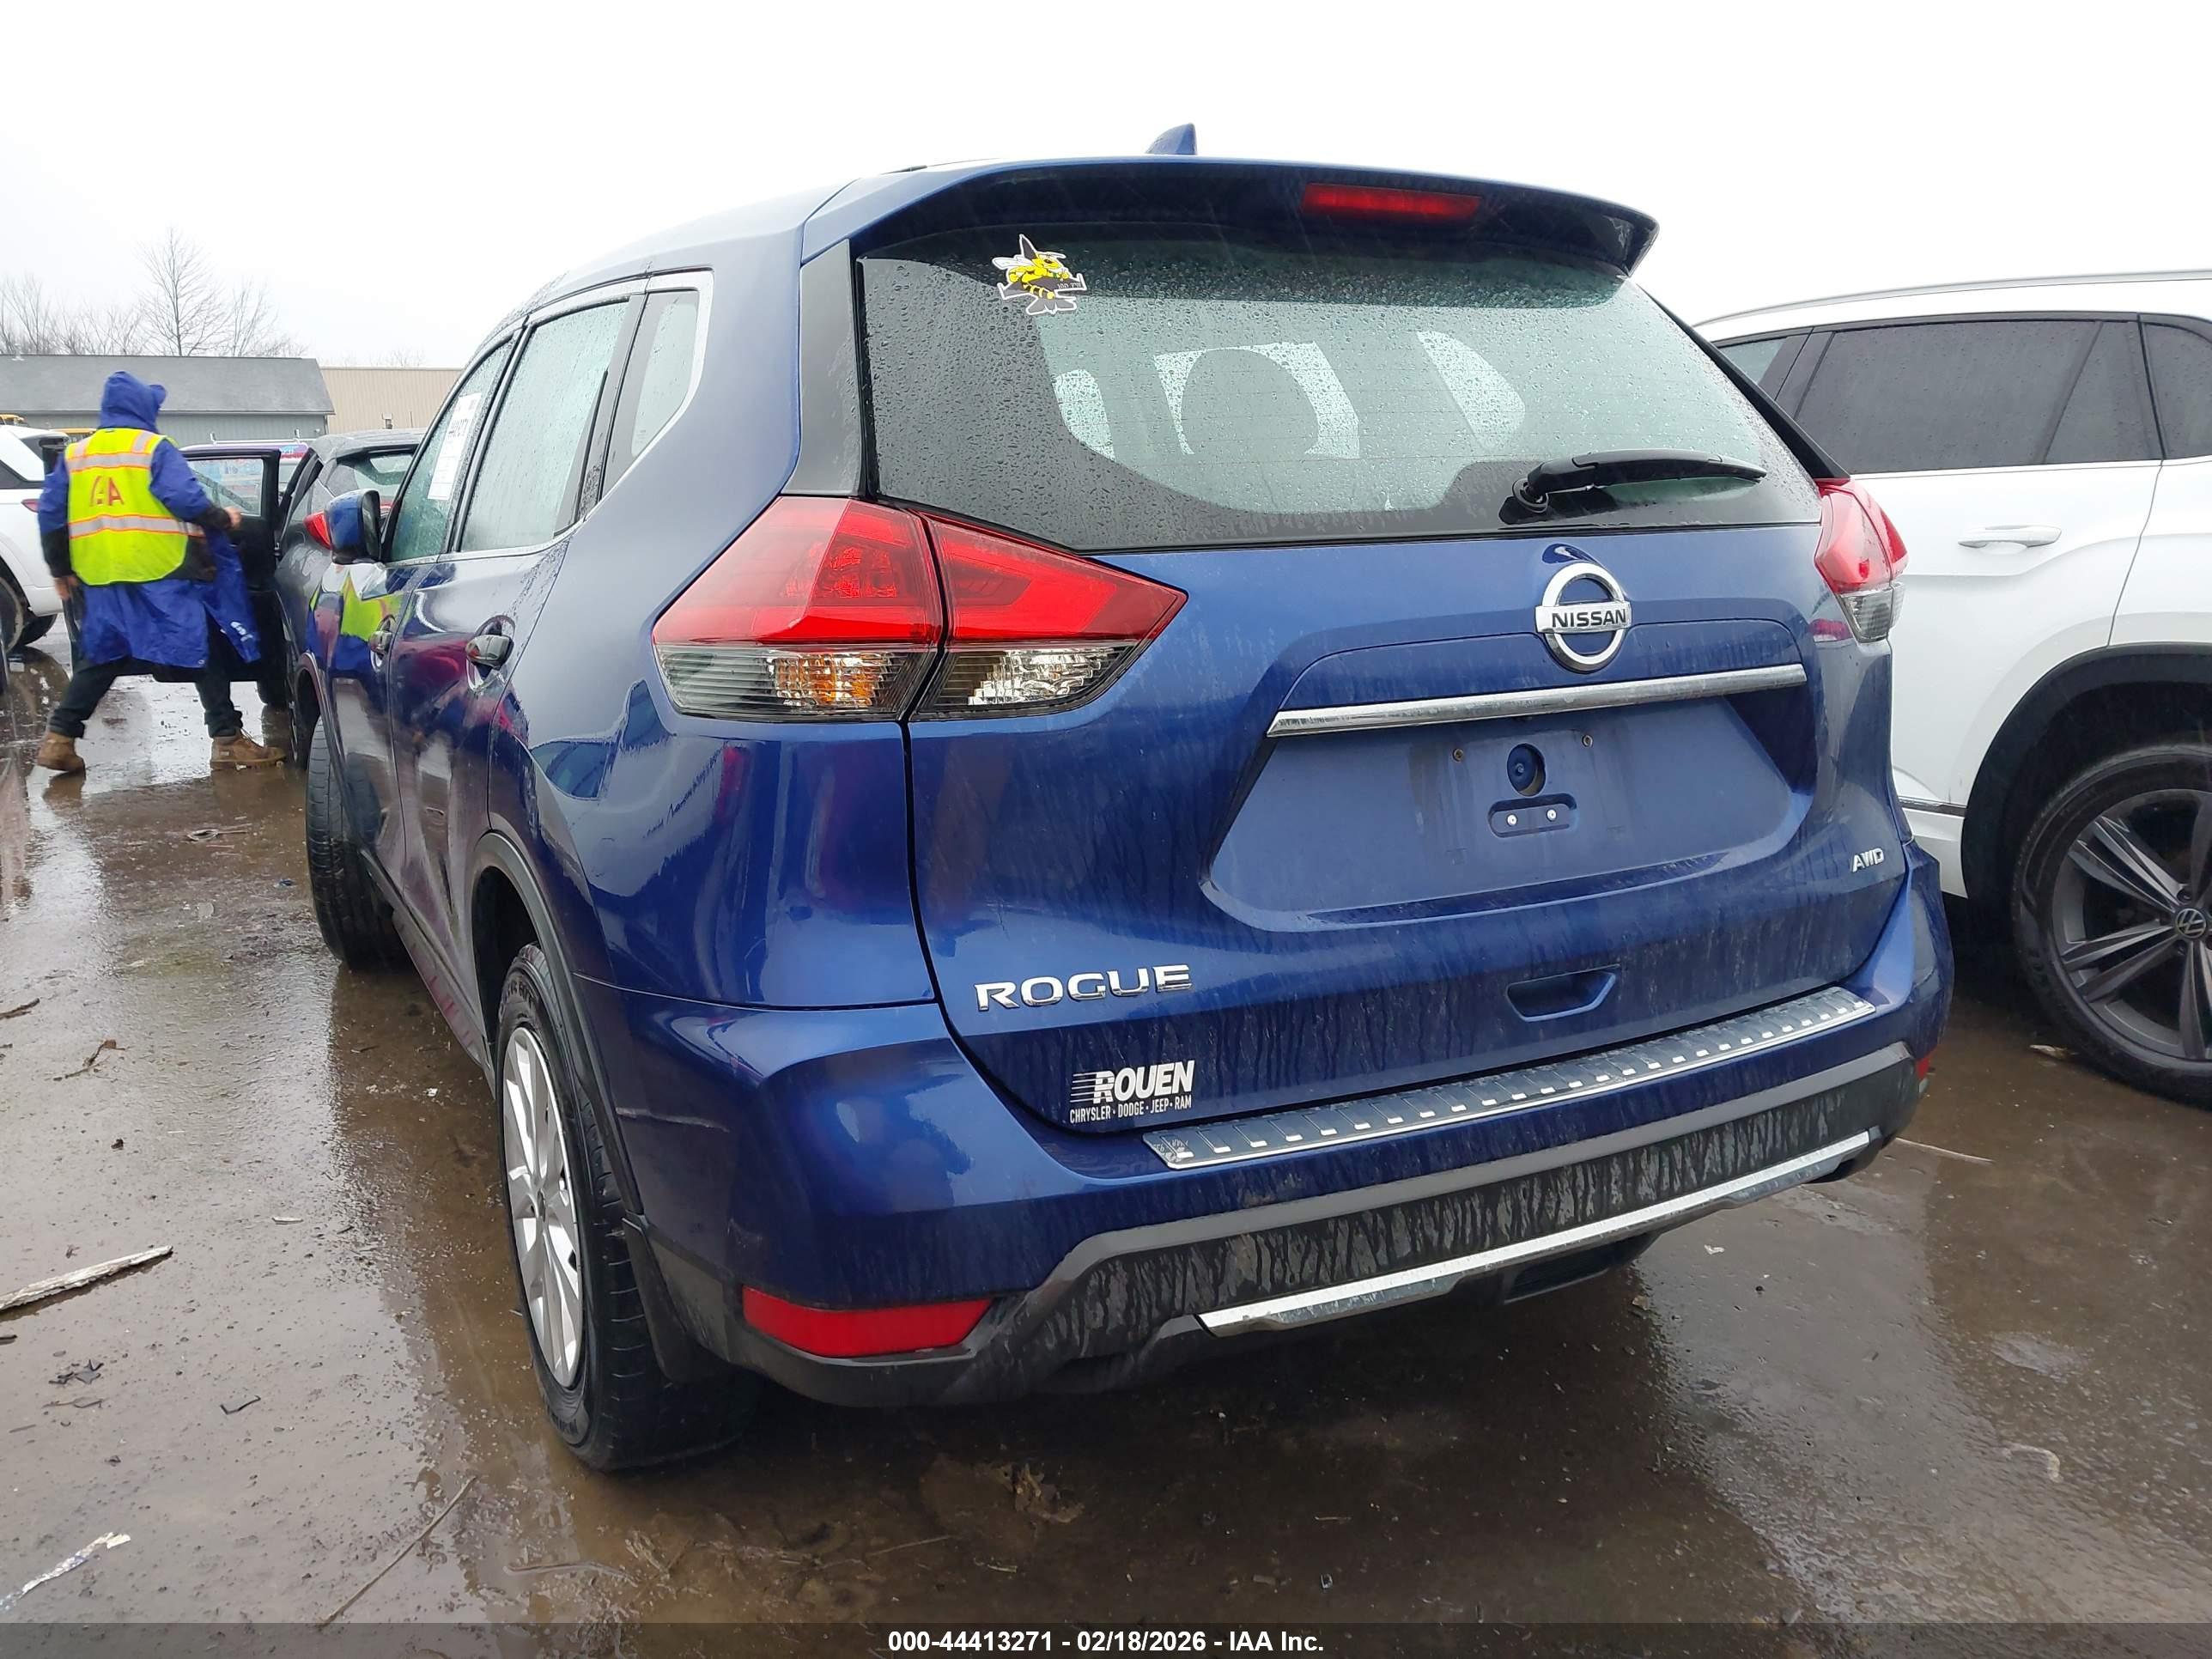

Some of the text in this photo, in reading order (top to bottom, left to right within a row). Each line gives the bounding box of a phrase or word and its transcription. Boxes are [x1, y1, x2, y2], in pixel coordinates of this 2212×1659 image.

[1552, 609, 1626, 629] NISSAN
[1850, 848, 1885, 872] AWD
[975, 963, 1193, 1012] ROGUE
[1092, 1060, 1195, 1104] ROUEN
[1070, 1094, 1192, 1124] CHRYSLER DODGE JEEP RAM
